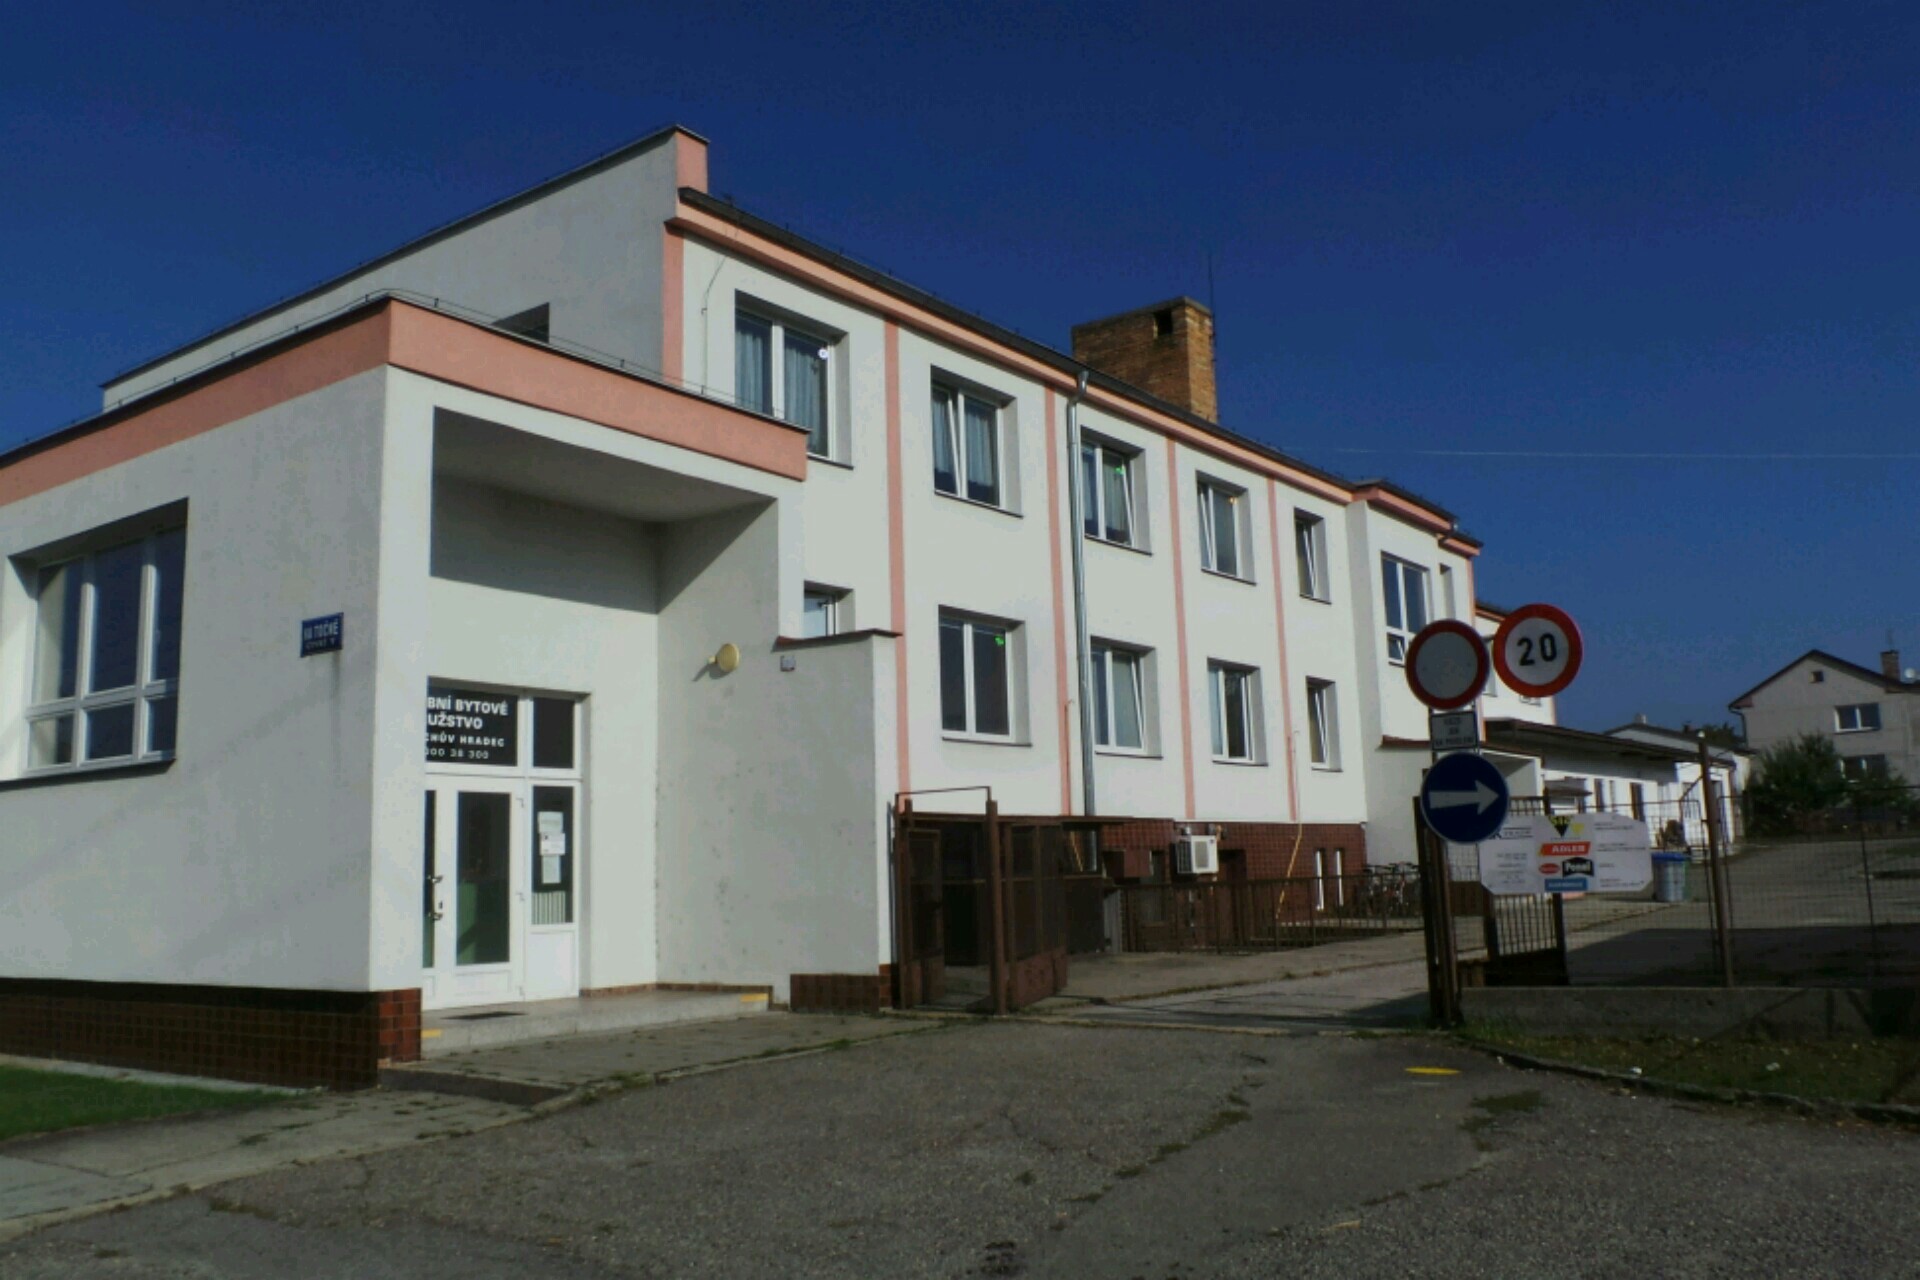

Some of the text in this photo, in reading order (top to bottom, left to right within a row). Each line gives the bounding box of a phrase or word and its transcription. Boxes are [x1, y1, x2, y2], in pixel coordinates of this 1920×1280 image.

[1516, 632, 1557, 666] 20
[455, 699, 509, 716] BYTOVÉ
[427, 711, 483, 730] UŽSTVO
[460, 735, 505, 748] HRADEC
[1552, 844, 1586, 854] ADLER
